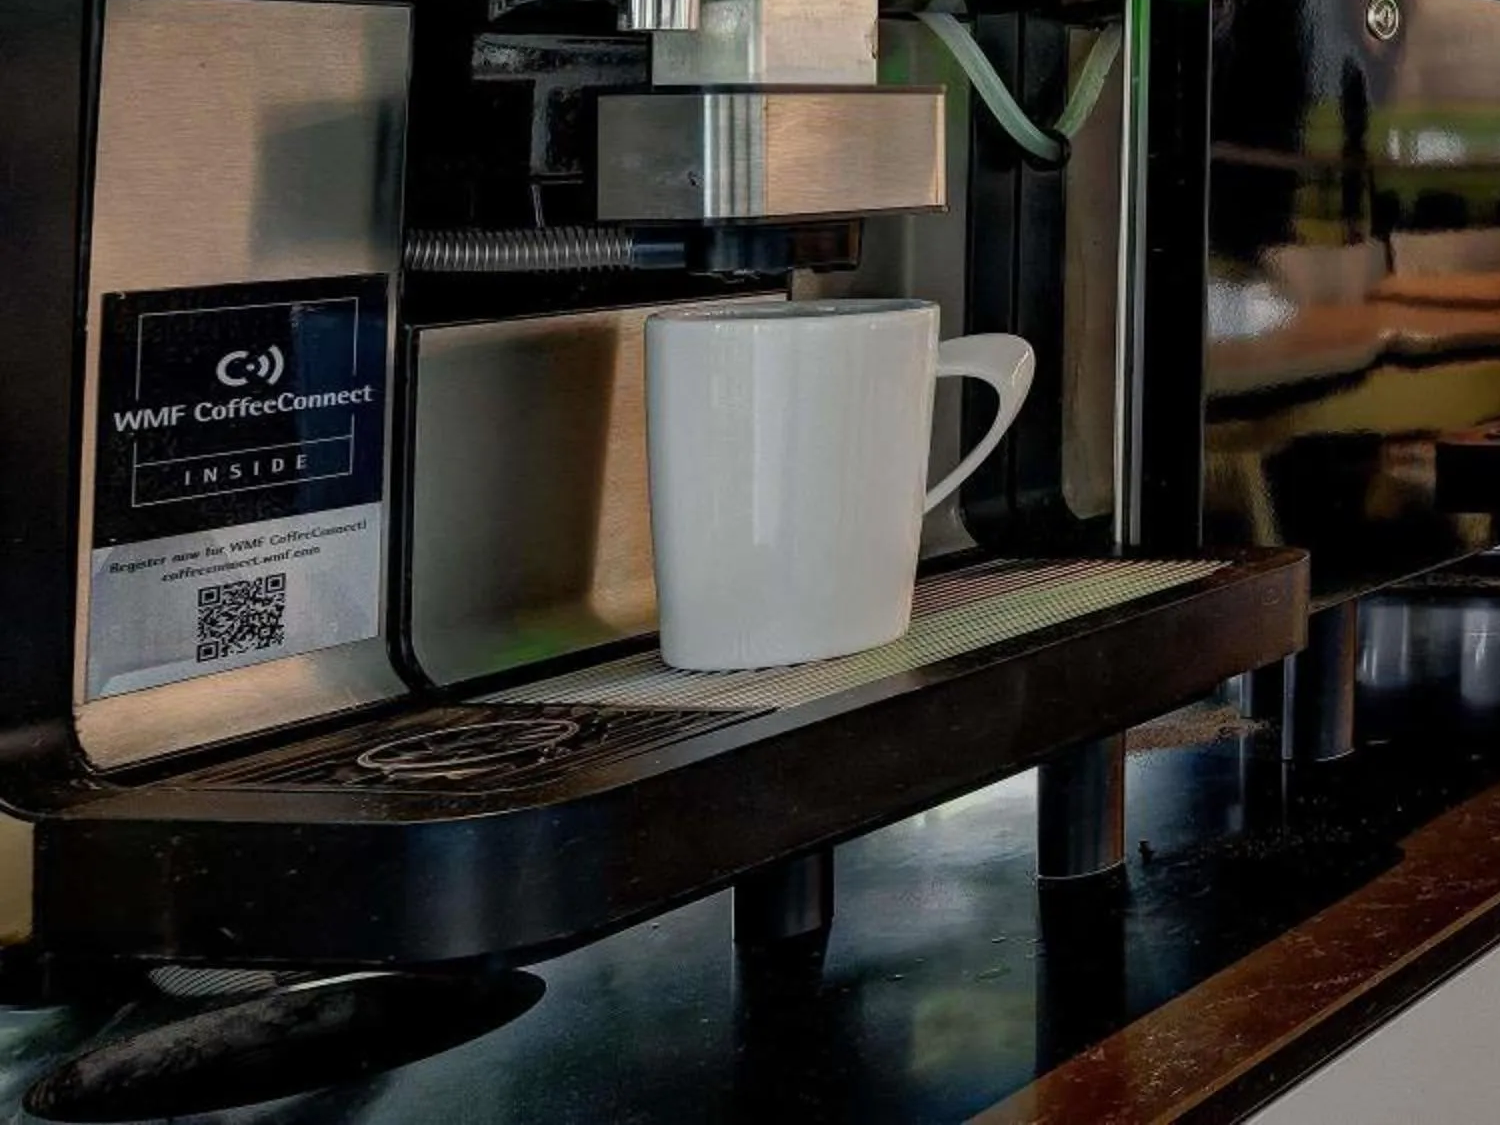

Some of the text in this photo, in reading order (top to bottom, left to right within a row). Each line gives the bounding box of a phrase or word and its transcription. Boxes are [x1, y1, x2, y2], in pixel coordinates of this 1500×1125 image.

[113, 384, 374, 432] WMF CoffeeConnect
[184, 453, 309, 486] INSIDE
[229, 536, 265, 554] WMF
